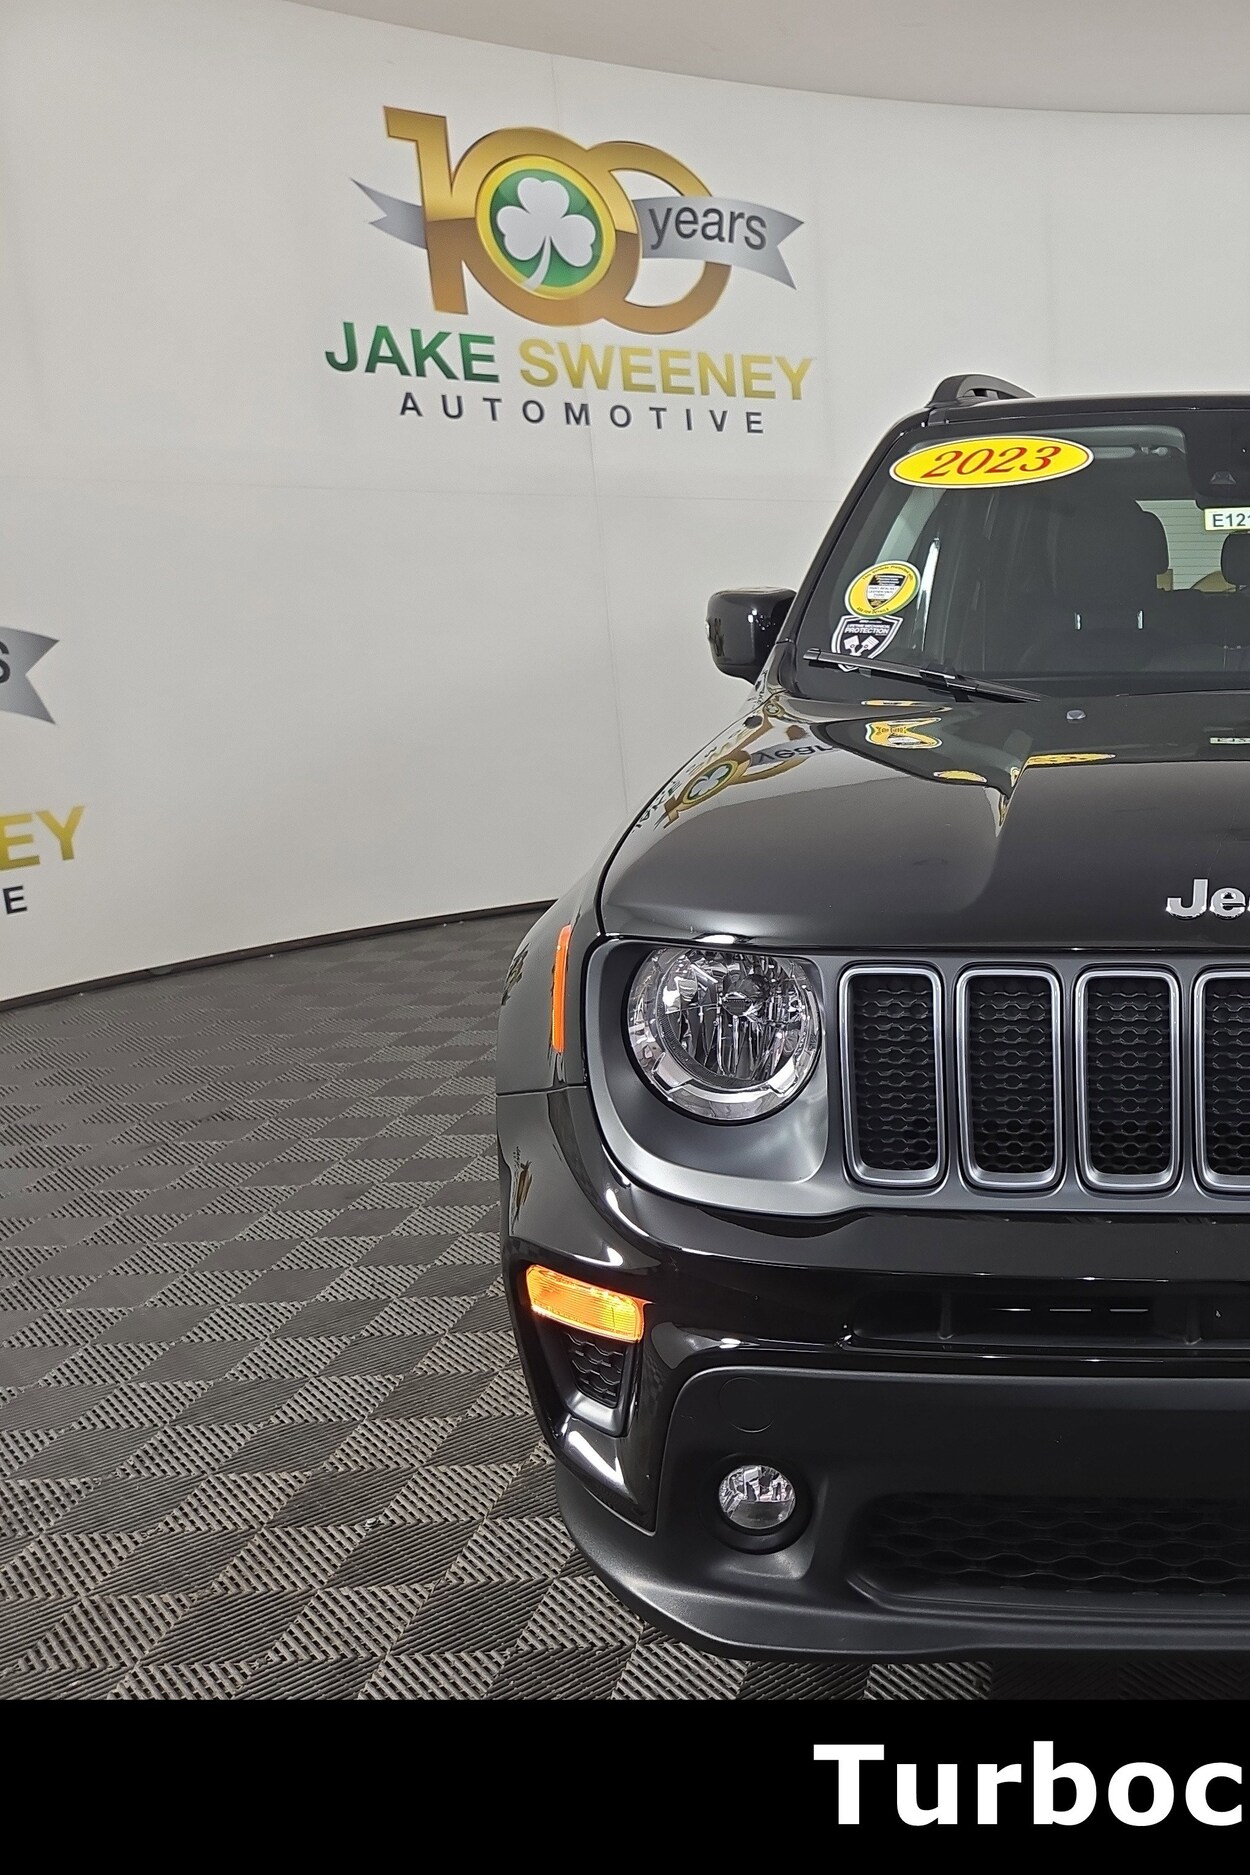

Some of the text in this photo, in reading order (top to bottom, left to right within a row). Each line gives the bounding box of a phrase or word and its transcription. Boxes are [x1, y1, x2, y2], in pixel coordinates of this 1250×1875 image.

[648, 204, 768, 251] years
[325, 321, 814, 401] JAKE SWEENEY
[399, 392, 764, 434] AUTOMOTIVE
[920, 445, 1062, 479] 2023
